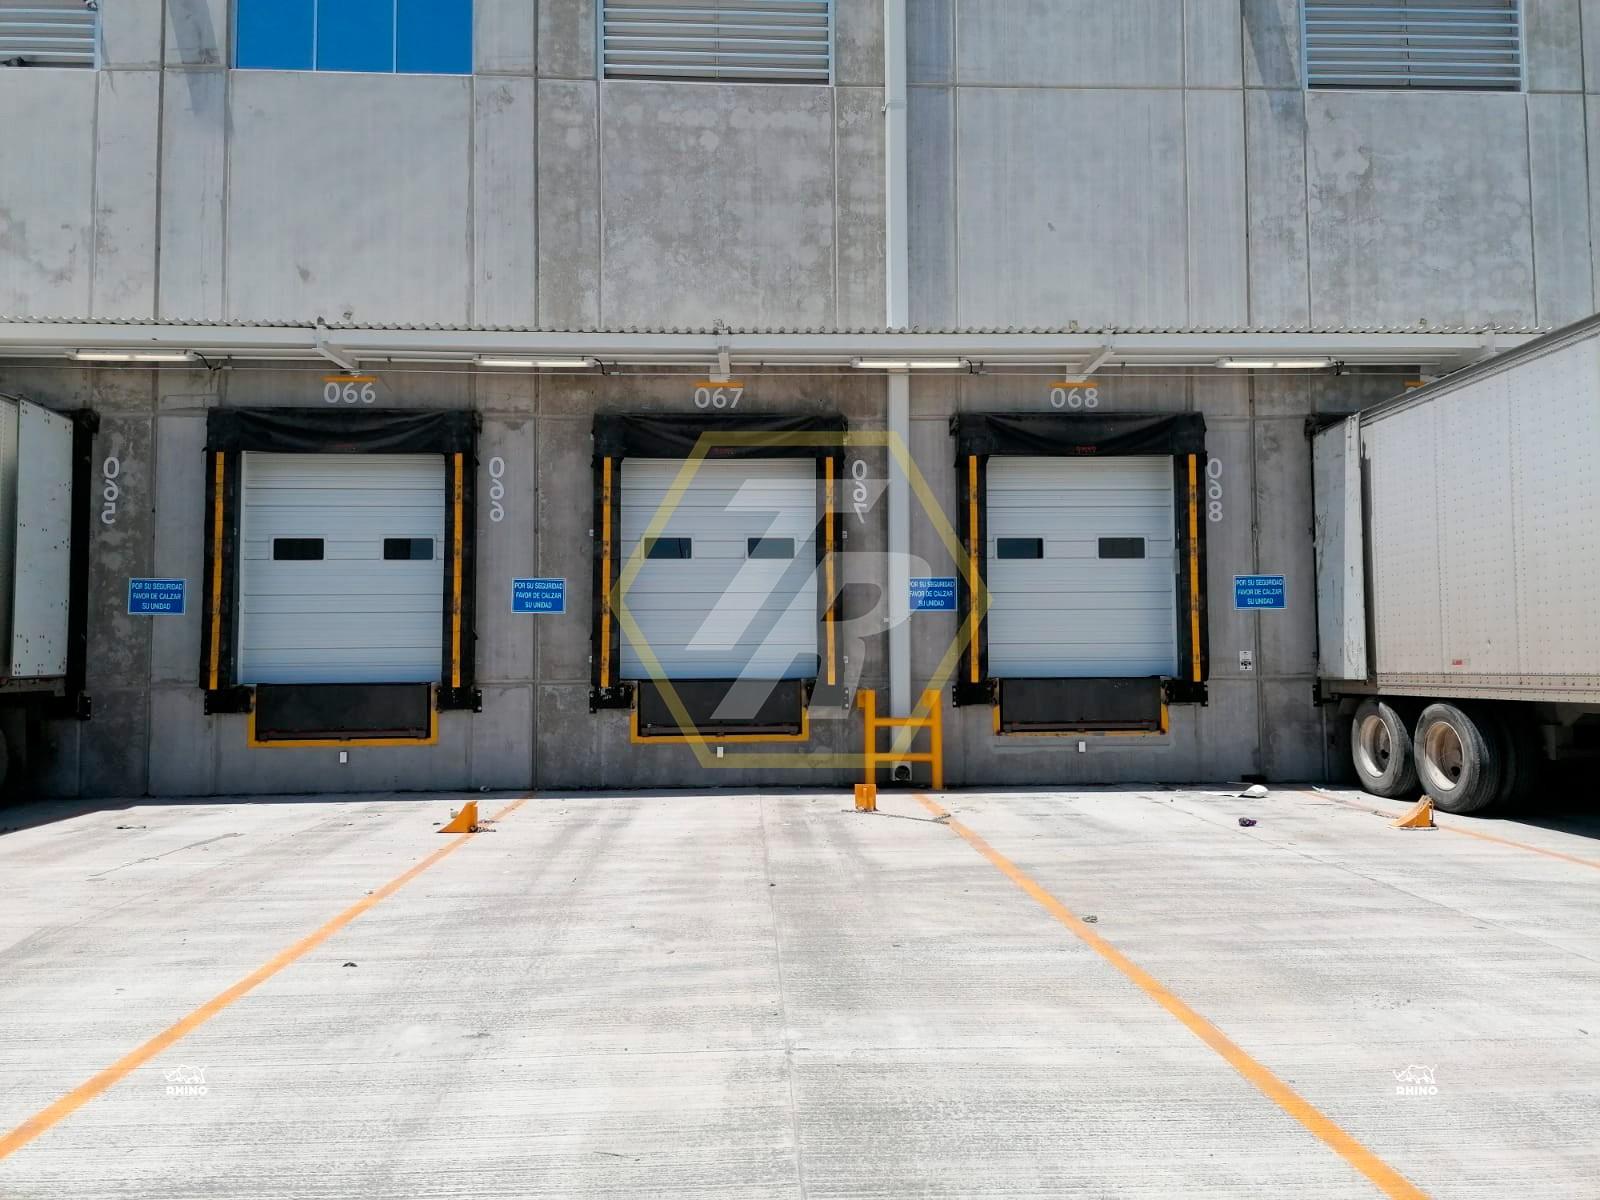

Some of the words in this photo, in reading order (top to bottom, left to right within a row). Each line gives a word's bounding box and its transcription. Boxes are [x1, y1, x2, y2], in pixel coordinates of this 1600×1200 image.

[324, 382, 376, 404] 066
[694, 387, 744, 408] 067
[1050, 387, 1098, 409] 068
[101, 456, 120, 524] 065
[488, 456, 505, 522] 066
[851, 459, 868, 524] 067
[1206, 457, 1223, 522] 068
[131, 582, 143, 590] POR
[144, 582, 151, 590] SU
[527, 582, 534, 590] SU
[133, 592, 150, 600] FAVOR
[150, 592, 158, 600] DE
[159, 592, 182, 600] CALZAR
[515, 591, 531, 599] FAVOR
[1247, 597, 1255, 605] SU
[1255, 597, 1274, 605] UNIDAD
[142, 602, 150, 610] SU
[150, 602, 171, 610] UNIDAD
[525, 601, 533, 609] SU
[533, 601, 552, 609] UNIDAD
